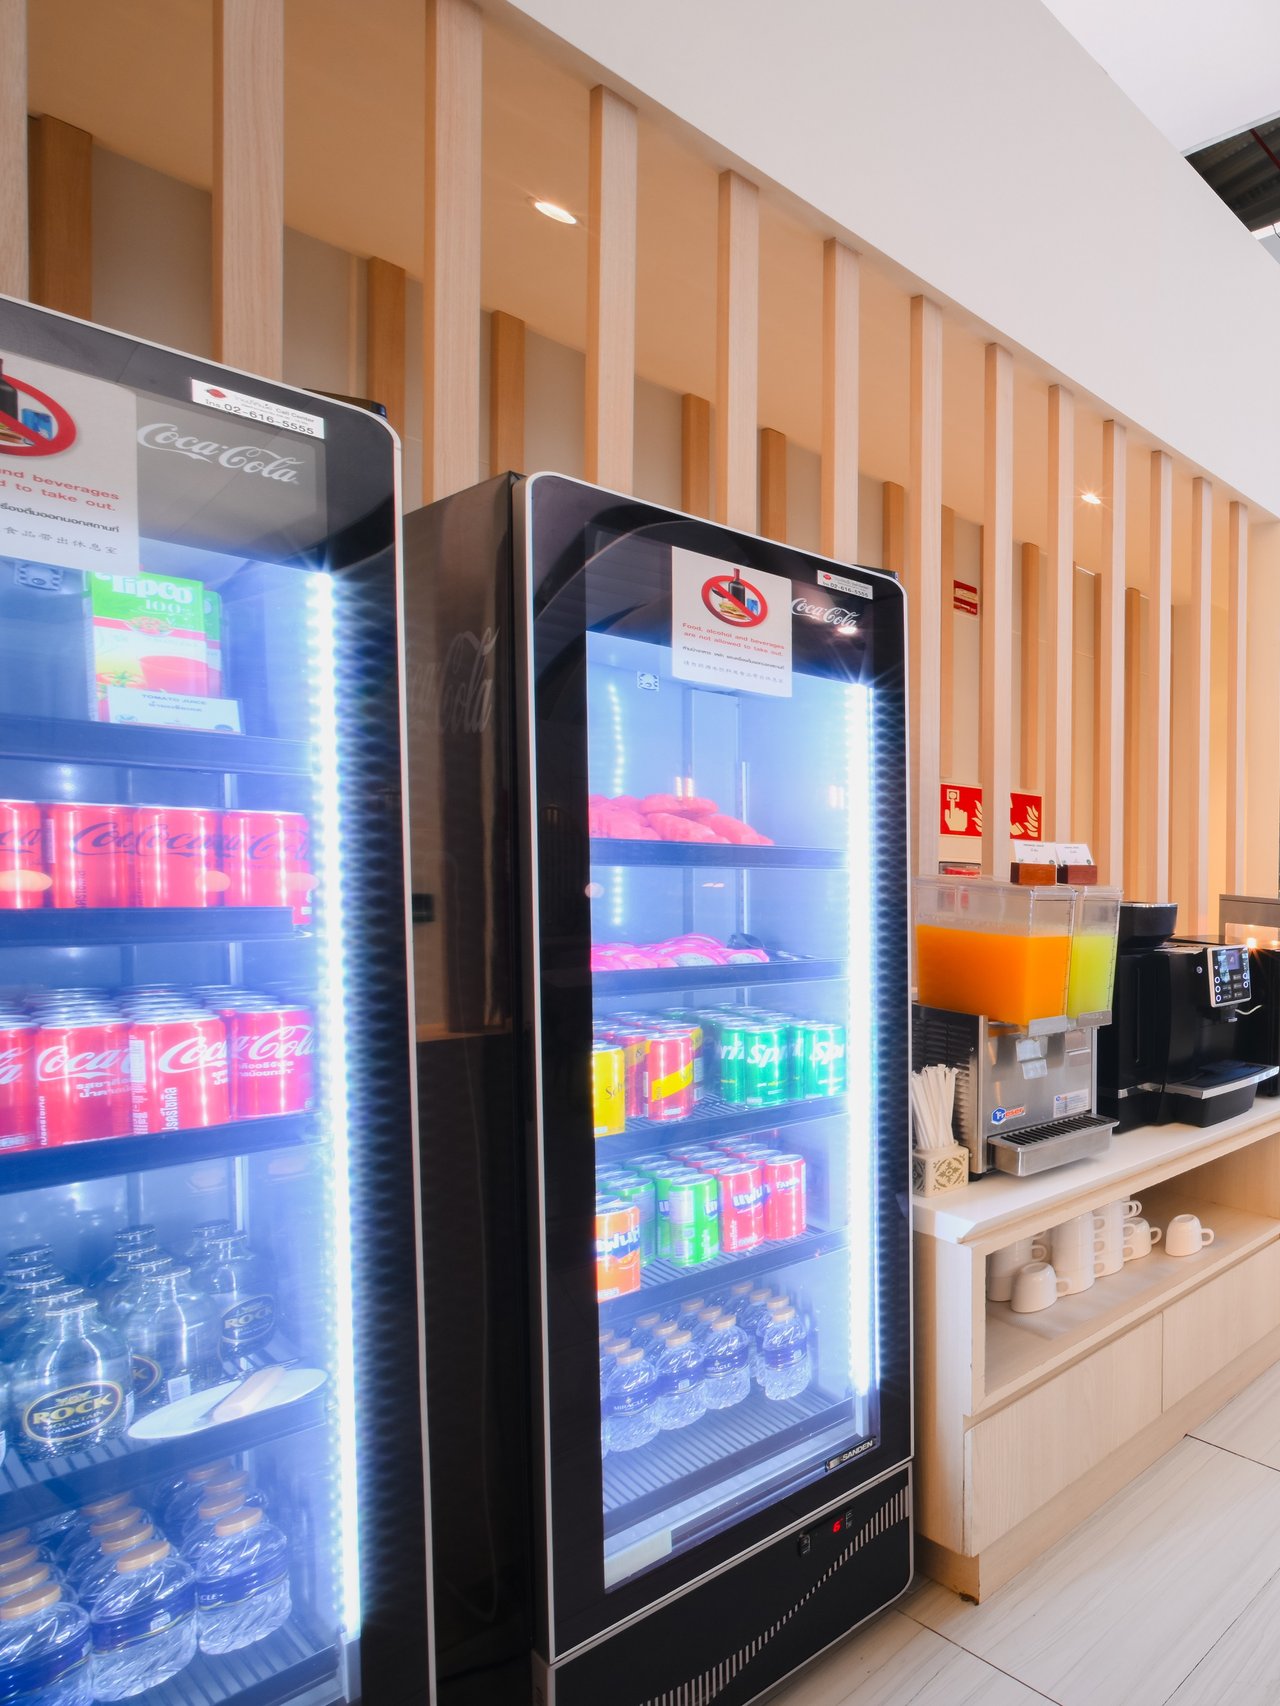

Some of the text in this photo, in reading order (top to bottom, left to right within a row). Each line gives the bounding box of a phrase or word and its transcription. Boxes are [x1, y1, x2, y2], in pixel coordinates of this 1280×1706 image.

[224, 403, 315, 435] 02-616-5555
[137, 423, 305, 485] Coca-Cola
[0, 468, 120, 500] nd beverages
[15, 483, 33, 493] to
[41, 488, 78, 503] take
[85, 499, 116, 512] out.
[791, 597, 860, 628] Coca-Cola
[706, 628, 733, 638] alcohol
[735, 634, 748, 642] and
[750, 637, 785, 650] beverages
[713, 637, 741, 648] allowed
[32, 1392, 114, 1425] ROCK
[842, 1440, 873, 1461] SANDEN
